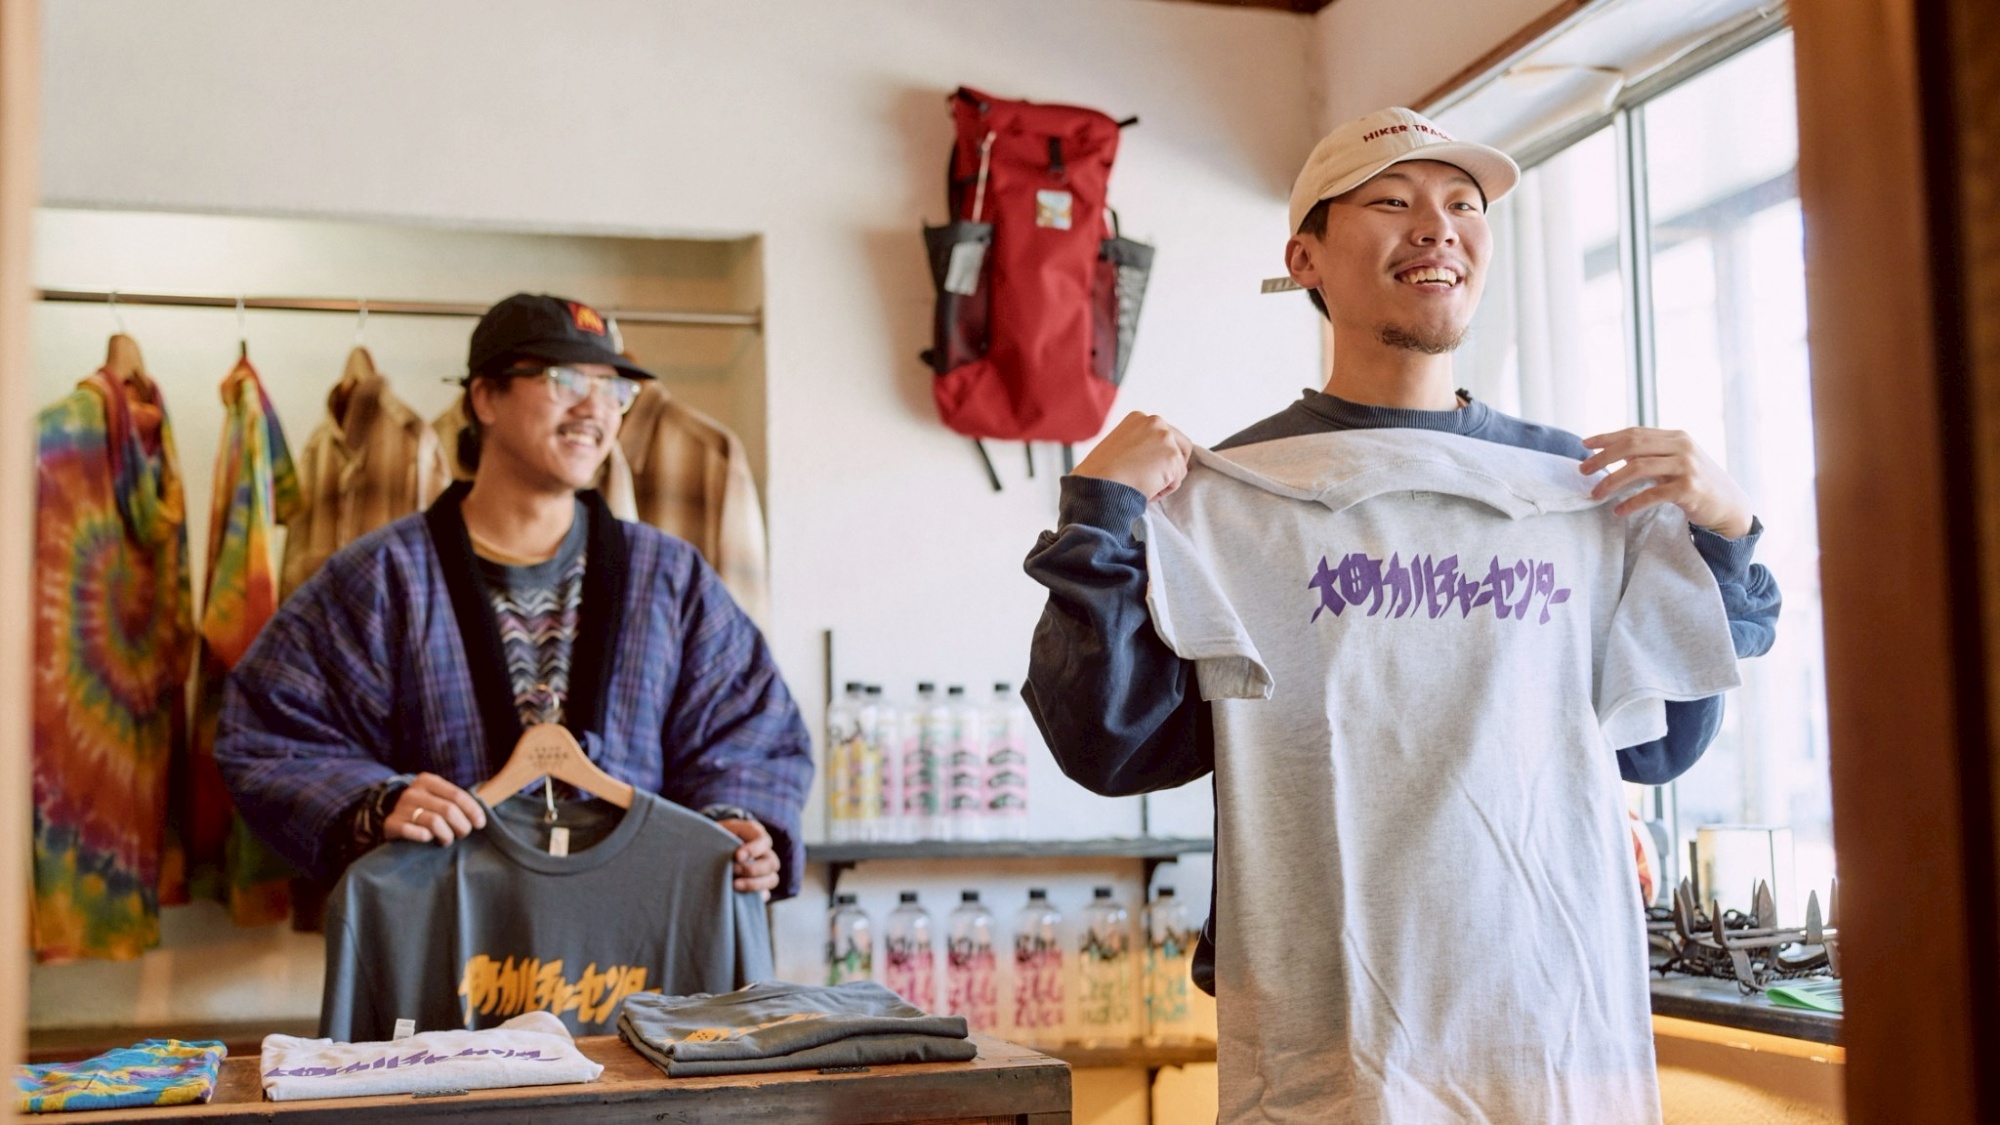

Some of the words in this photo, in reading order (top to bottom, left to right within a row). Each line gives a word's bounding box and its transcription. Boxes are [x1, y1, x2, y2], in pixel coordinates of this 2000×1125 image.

[1363, 125, 1409, 142] HIKER
[1308, 551, 1571, 625] 大町カルチャーセンター
